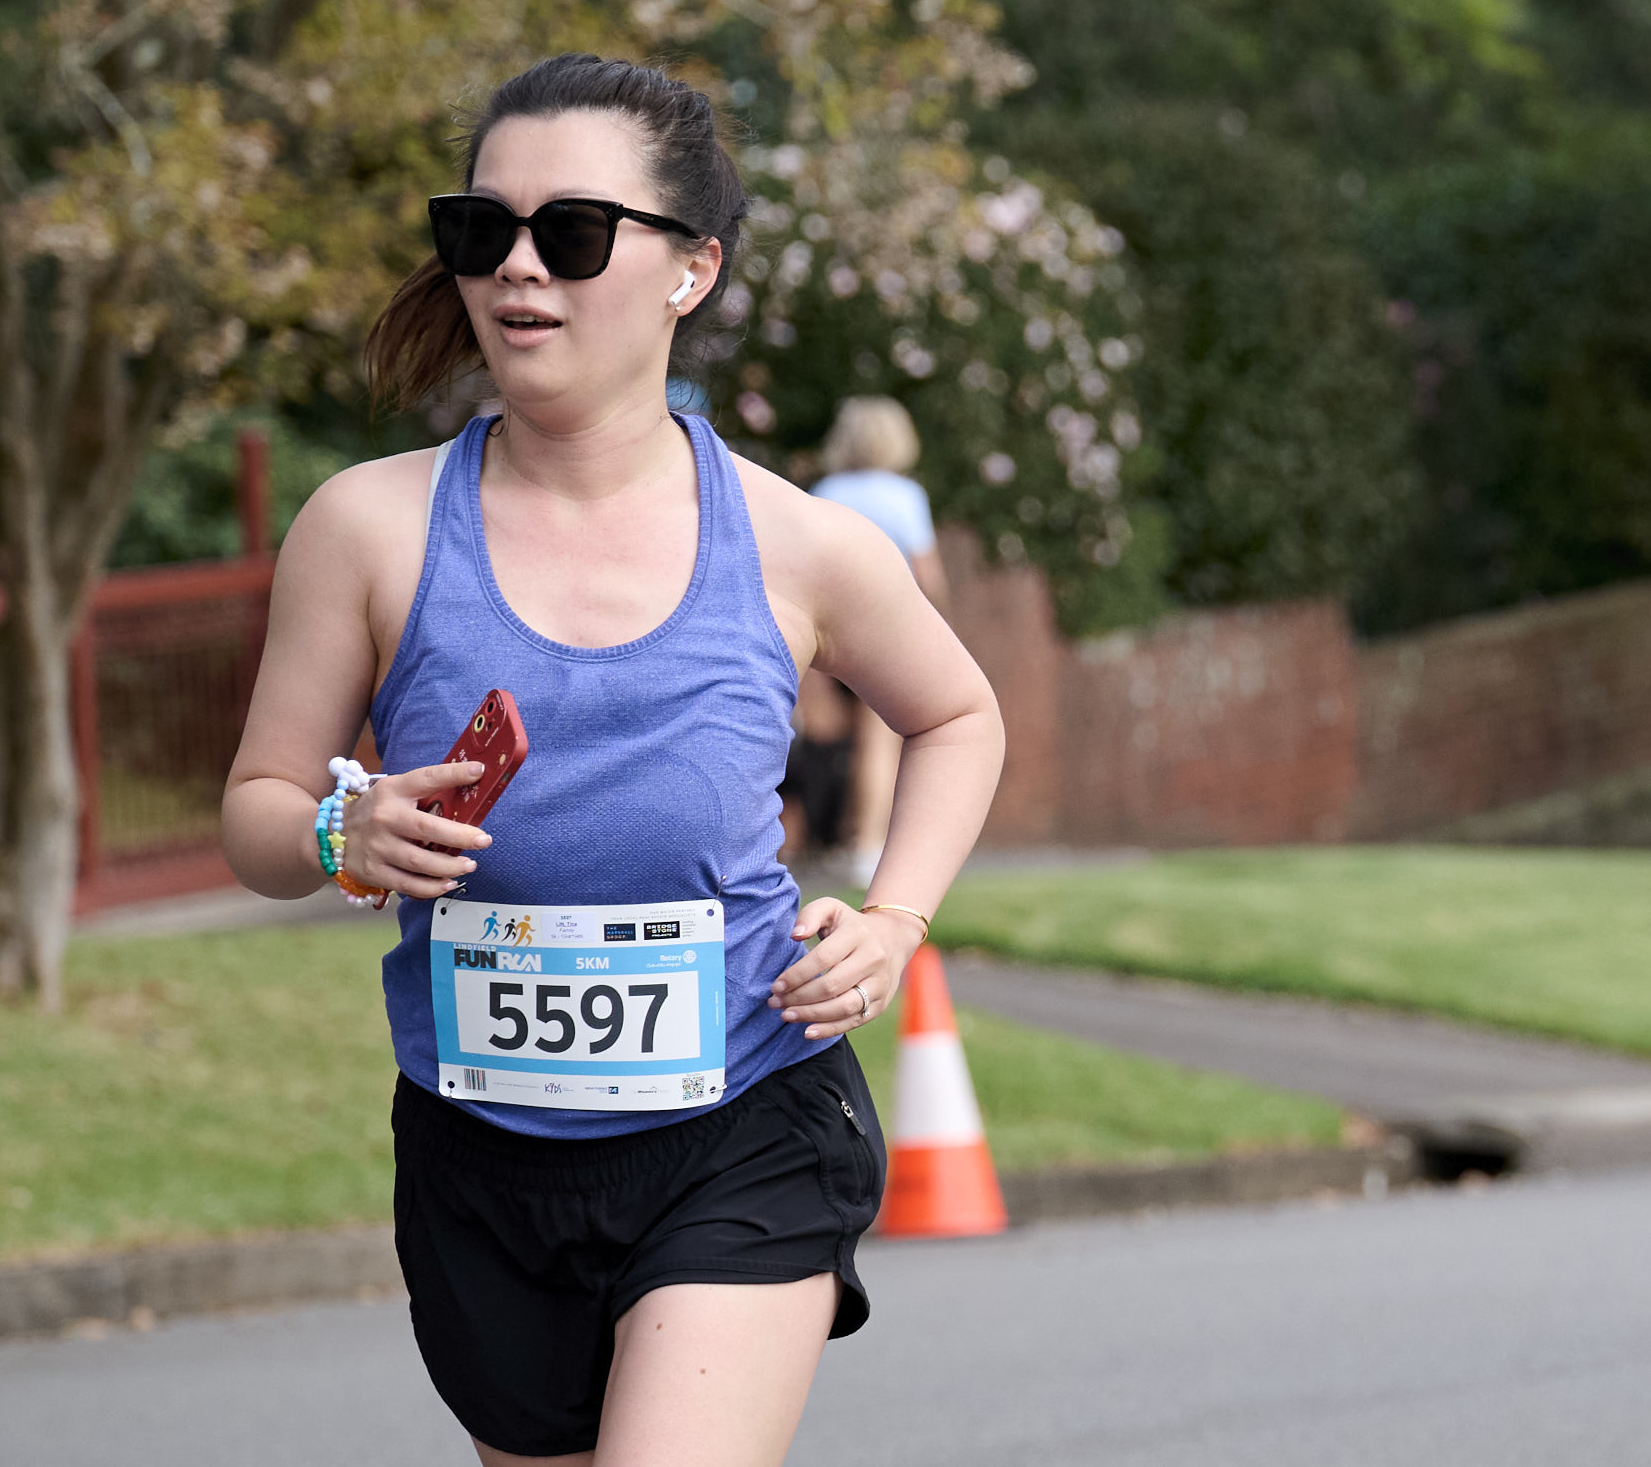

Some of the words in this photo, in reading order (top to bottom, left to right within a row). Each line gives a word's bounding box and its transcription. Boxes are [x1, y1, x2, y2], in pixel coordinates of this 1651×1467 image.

[453, 942, 496, 951] LINDFIELD
[454, 948, 497, 969] FUN
[497, 951, 542, 972] RUN
[575, 957, 610, 970] 5KM
[660, 954, 682, 962] Rotary
[488, 981, 669, 1055] 5597
